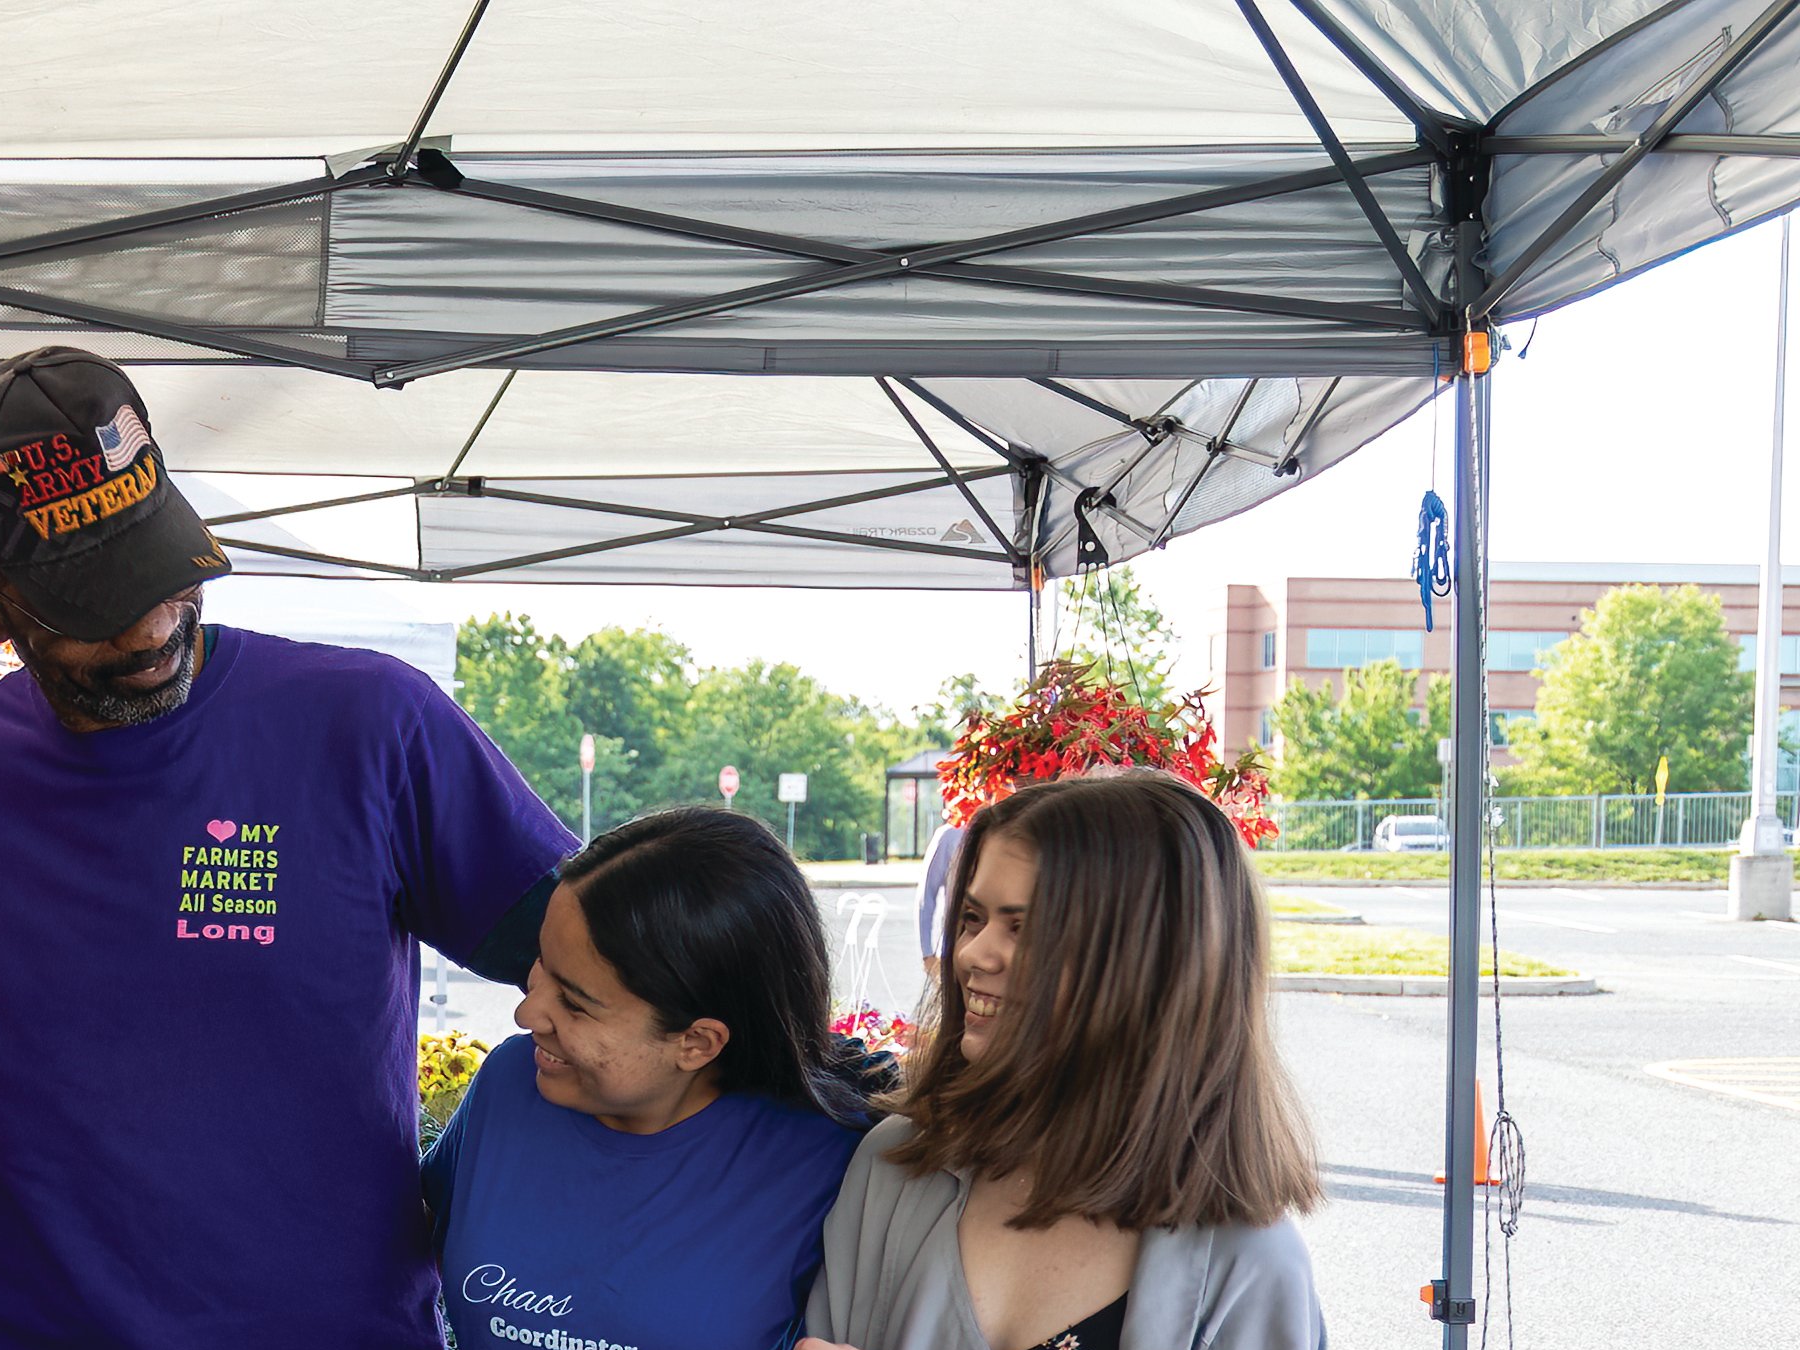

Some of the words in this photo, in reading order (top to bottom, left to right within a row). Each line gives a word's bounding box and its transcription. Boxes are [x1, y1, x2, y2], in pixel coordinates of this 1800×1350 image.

[21, 433, 81, 471] U.S.
[20, 454, 105, 507] ARMY
[241, 824, 280, 843] MY
[182, 846, 279, 869] FARMERS
[181, 869, 278, 892] MARKET
[179, 893, 206, 912] All
[211, 893, 277, 915] Season
[176, 919, 275, 945] Long
[462, 1263, 574, 1317] Chaos
